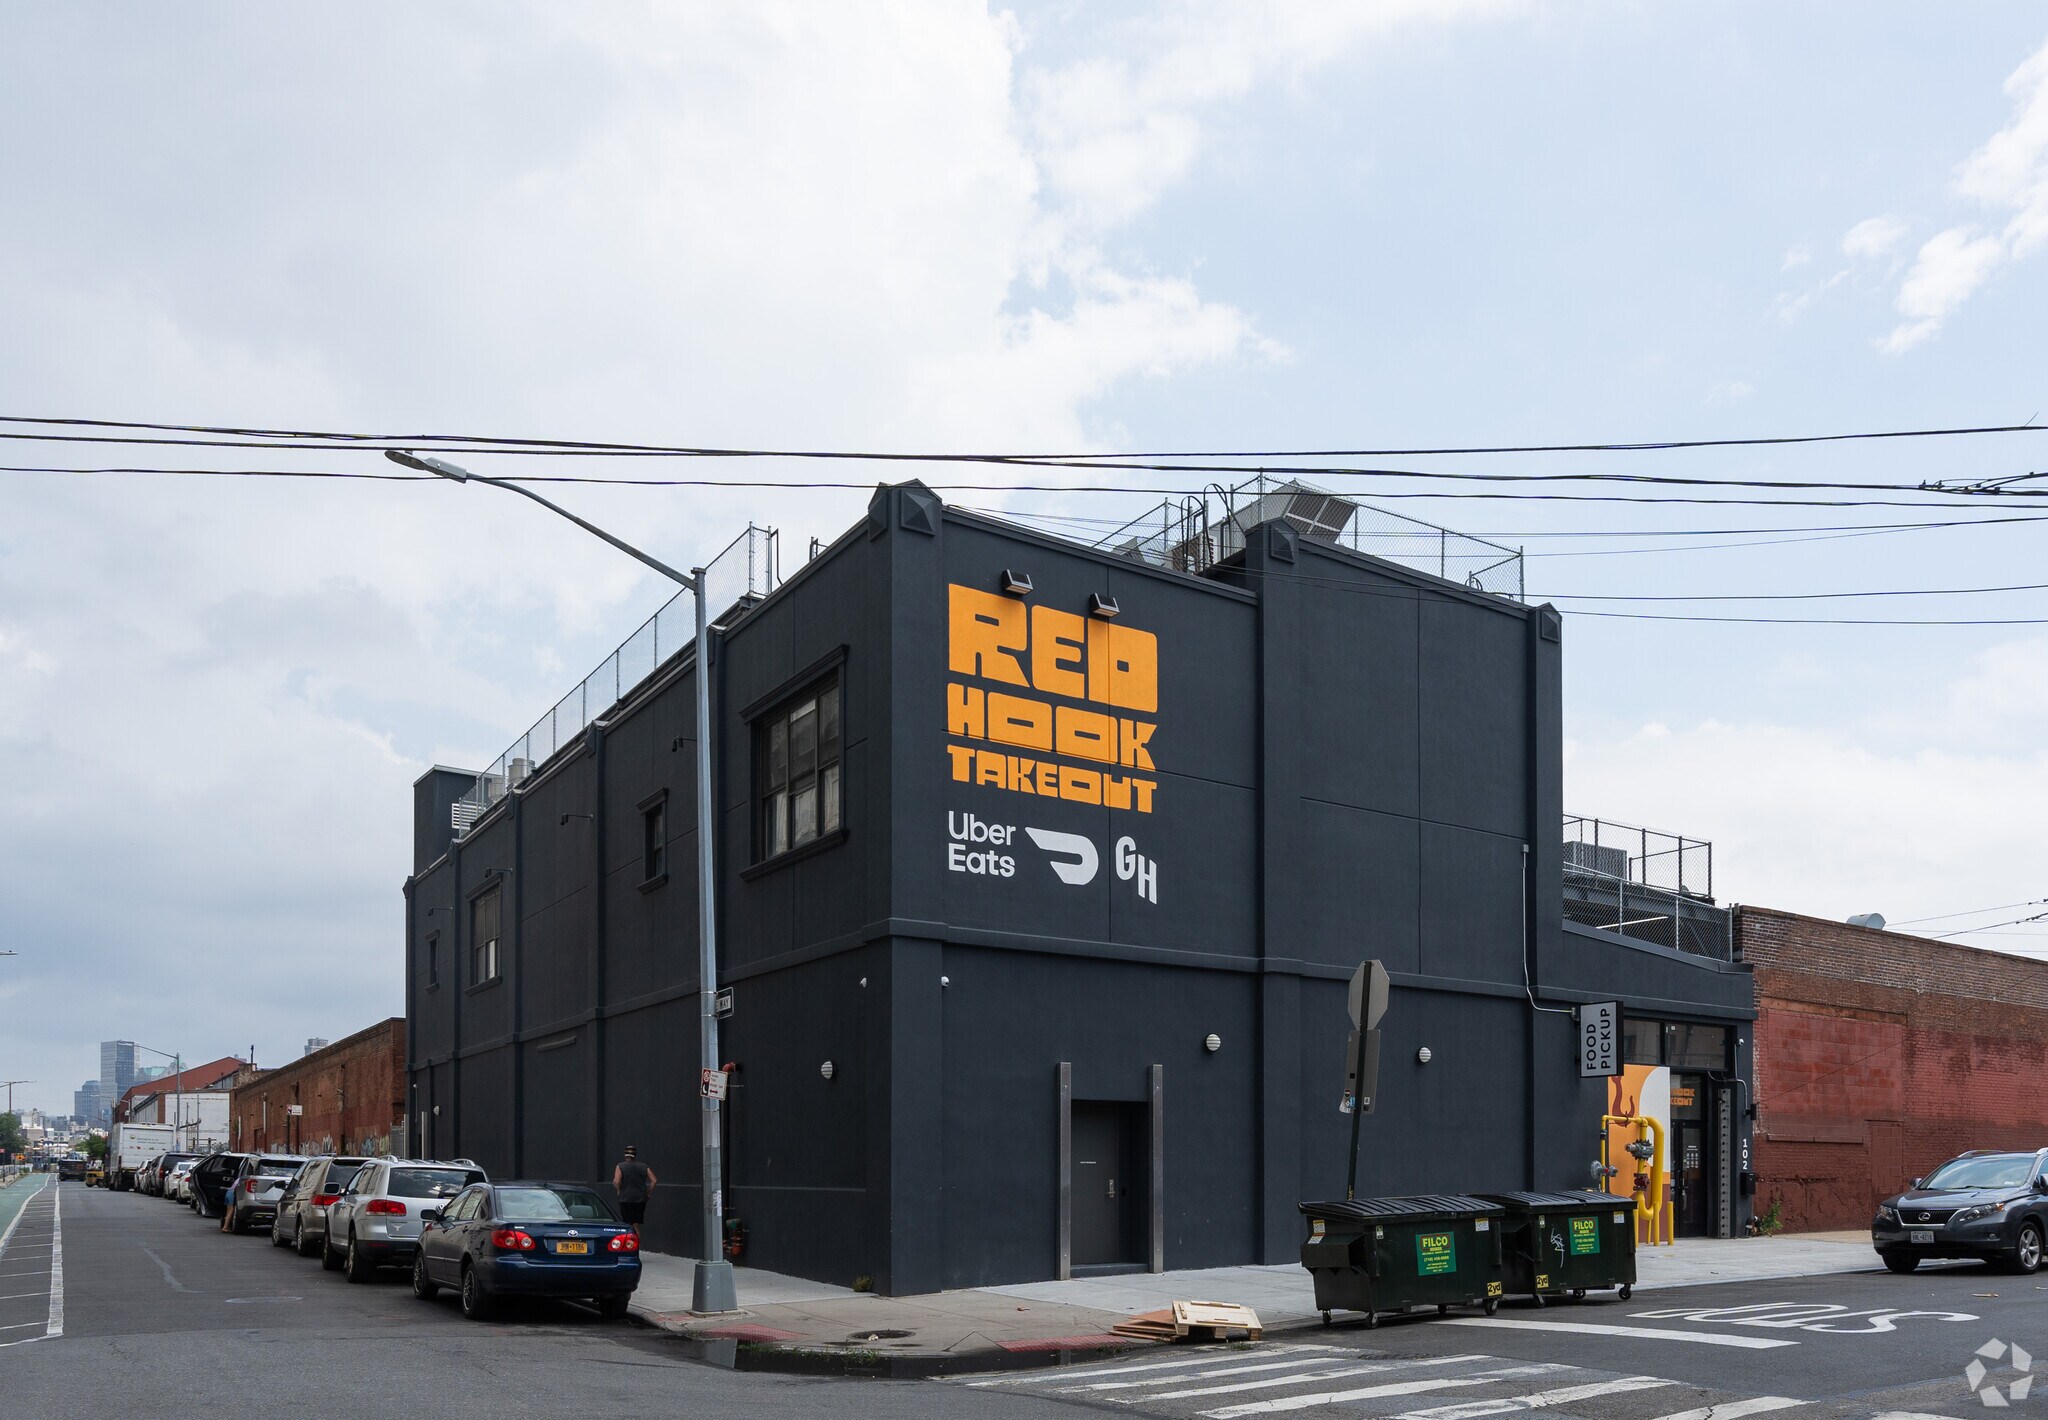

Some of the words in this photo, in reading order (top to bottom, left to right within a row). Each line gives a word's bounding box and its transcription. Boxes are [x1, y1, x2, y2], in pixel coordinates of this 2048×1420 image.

[949, 583, 1158, 713] RED
[947, 683, 1158, 772] HOOK
[947, 744, 1158, 814] TAKEOUT
[948, 810, 1016, 846] Uber
[948, 842, 1016, 878] Eats
[1115, 836, 1158, 905] GH
[1586, 1024, 1597, 1071] FOOD
[1600, 1008, 1611, 1070] PICKUP
[1422, 1236, 1448, 1248] FILCO
[1573, 1220, 1594, 1230] FILCO
[1487, 1282, 1501, 1294] 2yd
[1537, 1275, 1548, 1287] 2yd
[1626, 1302, 1980, 1333] STOP
